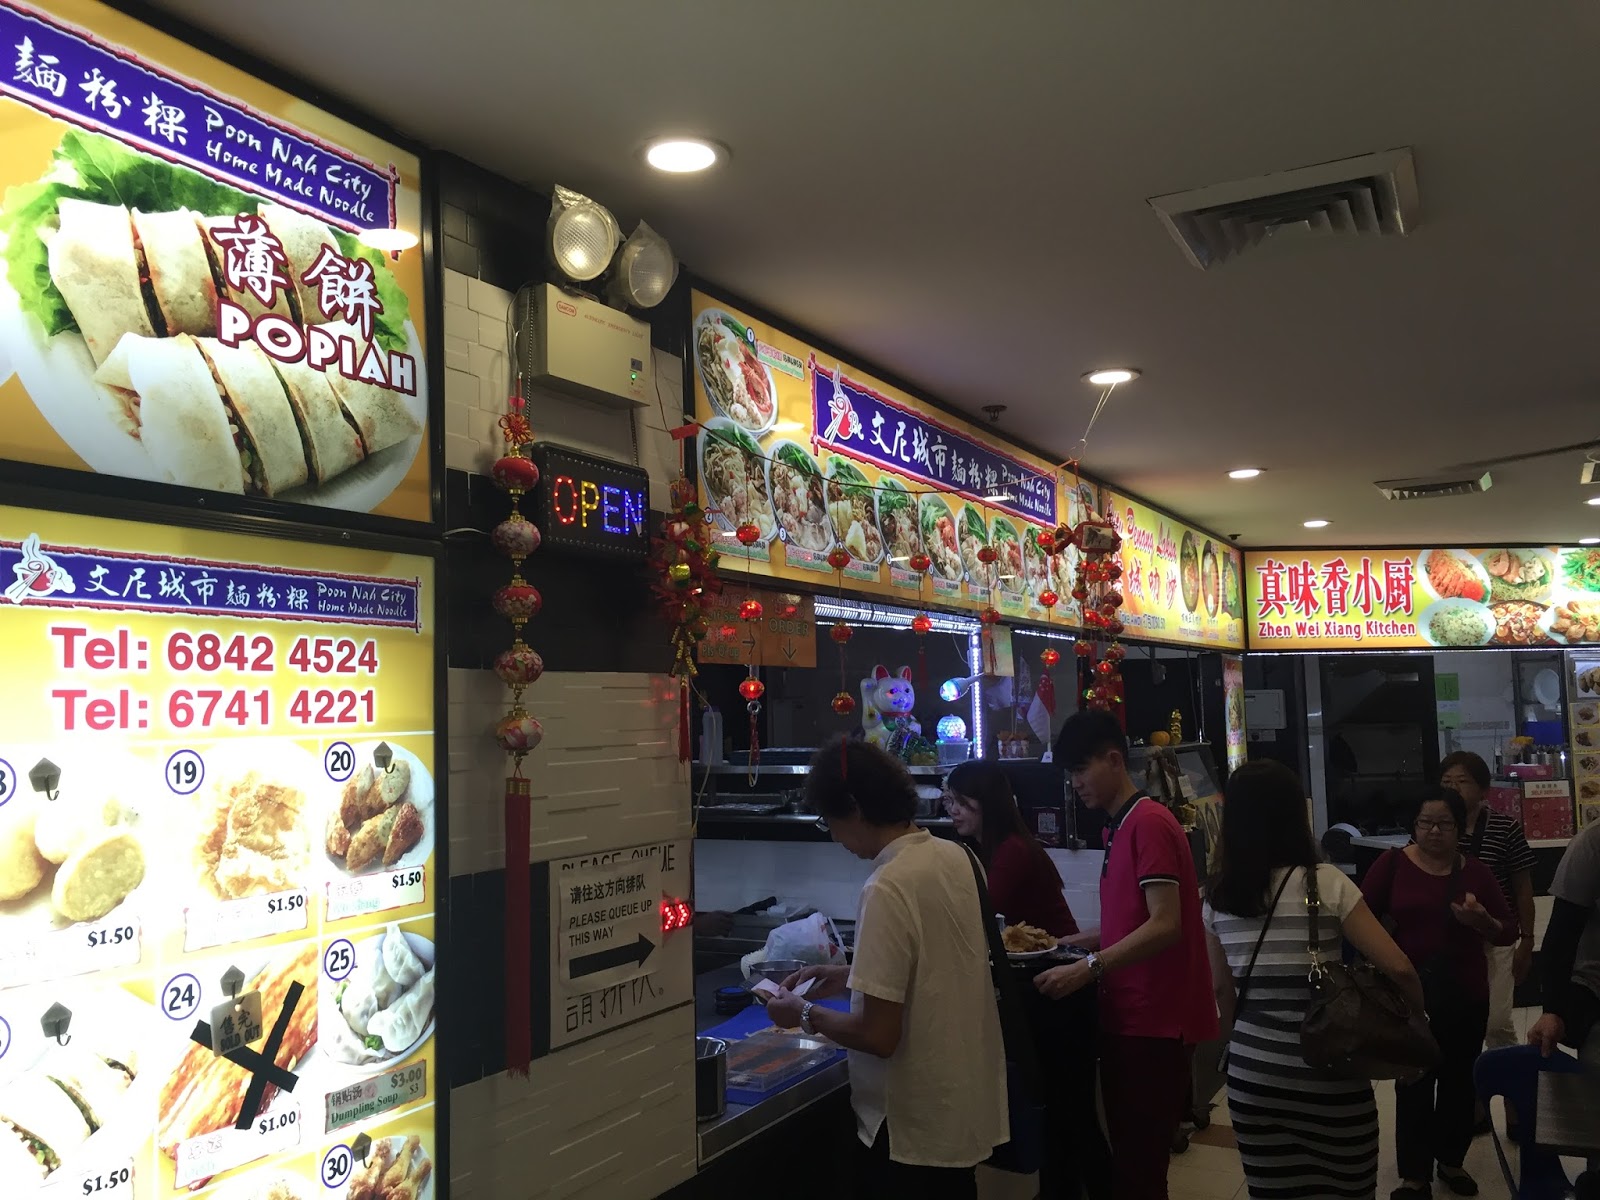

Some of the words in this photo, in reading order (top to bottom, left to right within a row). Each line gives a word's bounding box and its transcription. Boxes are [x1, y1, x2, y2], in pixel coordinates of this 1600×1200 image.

[204, 105, 262, 153] Poon
[271, 137, 317, 175] Nah
[326, 161, 373, 199] City
[205, 140, 258, 175] Home
[266, 163, 313, 198] Made
[319, 186, 374, 223] Noodle
[210, 213, 383, 341] 薄餅
[217, 299, 417, 396] POPIAH
[553, 475, 643, 538] OPEN
[317, 582, 346, 598] Poon
[352, 586, 376, 600] Nah
[381, 589, 406, 605] City
[1256, 557, 1416, 618] 真味香小厨
[318, 600, 344, 611] Home
[348, 602, 373, 614] Made
[377, 604, 407, 617] Noodle
[769, 618, 809, 637] ORDER
[1258, 622, 1291, 638] Zhen
[1296, 622, 1319, 637] Wei
[1324, 622, 1361, 639] Xiang
[1365, 621, 1416, 636] Kitchen
[51, 627, 147, 670] Tel:
[167, 632, 274, 671] 6842
[289, 638, 378, 673] 4524
[52, 689, 148, 730] Tel:
[168, 690, 269, 727] 6741
[290, 690, 374, 724] 4221
[172, 757, 197, 785] 19
[329, 750, 351, 773] 20
[392, 871, 421, 889] $1.50
[267, 894, 304, 914] $1.50
[569, 911, 606, 930] PLEASE
[608, 905, 639, 920] QUEUE
[640, 900, 652, 912] UP
[87, 926, 134, 949] $1.50
[569, 931, 590, 947] THIS
[593, 926, 614, 941] WAY
[329, 947, 350, 972] 25
[167, 983, 196, 1011] 24
[221, 1033, 240, 1052] SOLD
[245, 1025, 260, 1042] OUT
[391, 1068, 421, 1089] $3.00
[331, 1101, 374, 1124] Dumpling
[377, 1093, 398, 1107] Soup
[258, 1110, 297, 1136] $1.00
[328, 1153, 347, 1180] 30
[82, 1167, 129, 1196] $1.50
